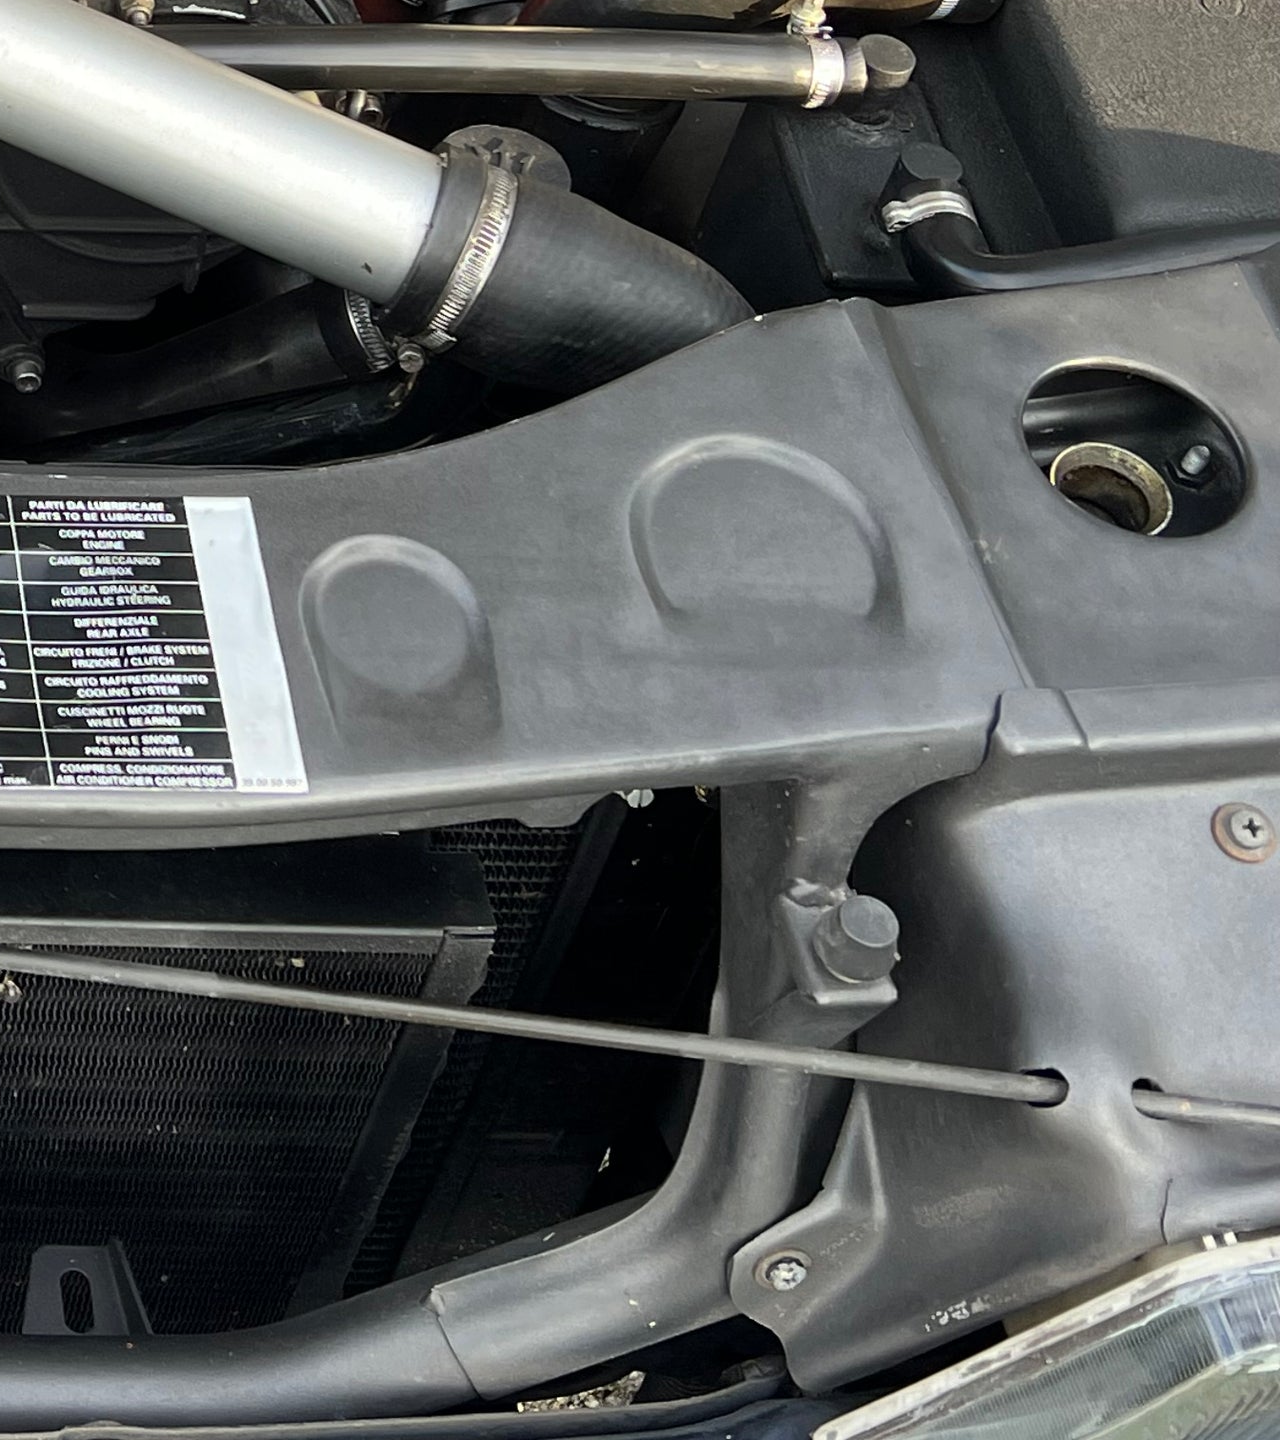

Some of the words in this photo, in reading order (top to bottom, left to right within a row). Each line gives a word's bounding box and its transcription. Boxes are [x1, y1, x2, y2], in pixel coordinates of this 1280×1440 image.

[28, 500, 64, 510] PARTI
[66, 501, 85, 510] DA
[88, 501, 165, 512] LUBRIFICARE
[21, 511, 62, 522] PARTS
[64, 512, 81, 522] TO
[84, 513, 98, 522] BE
[101, 512, 176, 523] LUBRICATED
[58, 529, 96, 539] COPPA
[96, 530, 146, 540] MOTORE
[82, 540, 125, 551] ENGINE
[48, 555, 93, 566] CAMBIO
[94, 556, 161, 566] MECCANICO
[79, 566, 134, 577] GEARBOX
[60, 585, 98, 596] GUIDA
[99, 584, 159, 596] IDRAULICA
[51, 596, 116, 607] HYDRAULIC
[116, 595, 172, 606] STEERING
[73, 615, 159, 627] DIFFERENZIALE
[86, 628, 118, 639] REAR
[119, 627, 150, 638] AXLE
[33, 646, 85, 658] CIRCUITO
[85, 647, 118, 657] FRENI
[126, 646, 163, 657] BRAKE
[163, 644, 210, 656] SYSTEM
[72, 657, 121, 669] FRIZIONE
[130, 656, 175, 667] CLUTCH
[43, 675, 98, 687] CIRCUITO
[98, 674, 209, 687] RAFFREDDAMENTO
[76, 687, 131, 699] COOLING
[131, 685, 181, 697] SYSTEM
[57, 705, 127, 718] CUSCINETTI
[127, 705, 165, 717] MOZZI
[165, 704, 207, 716] RUOTE
[86, 717, 129, 728] WHEEL
[129, 716, 182, 728] BEARING
[95, 735, 132, 746] PERNI
[132, 735, 140, 746] E
[140, 734, 180, 746] SNODI
[84, 746, 113, 757] PINS
[113, 746, 141, 757] AND
[141, 745, 195, 758] SWIVELS
[126, 763, 226, 776] CONDIZIONATORE
[56, 774, 78, 786] AIR
[78, 774, 155, 787] CONDITIONER
[155, 775, 234, 788] COMPRESSOR
